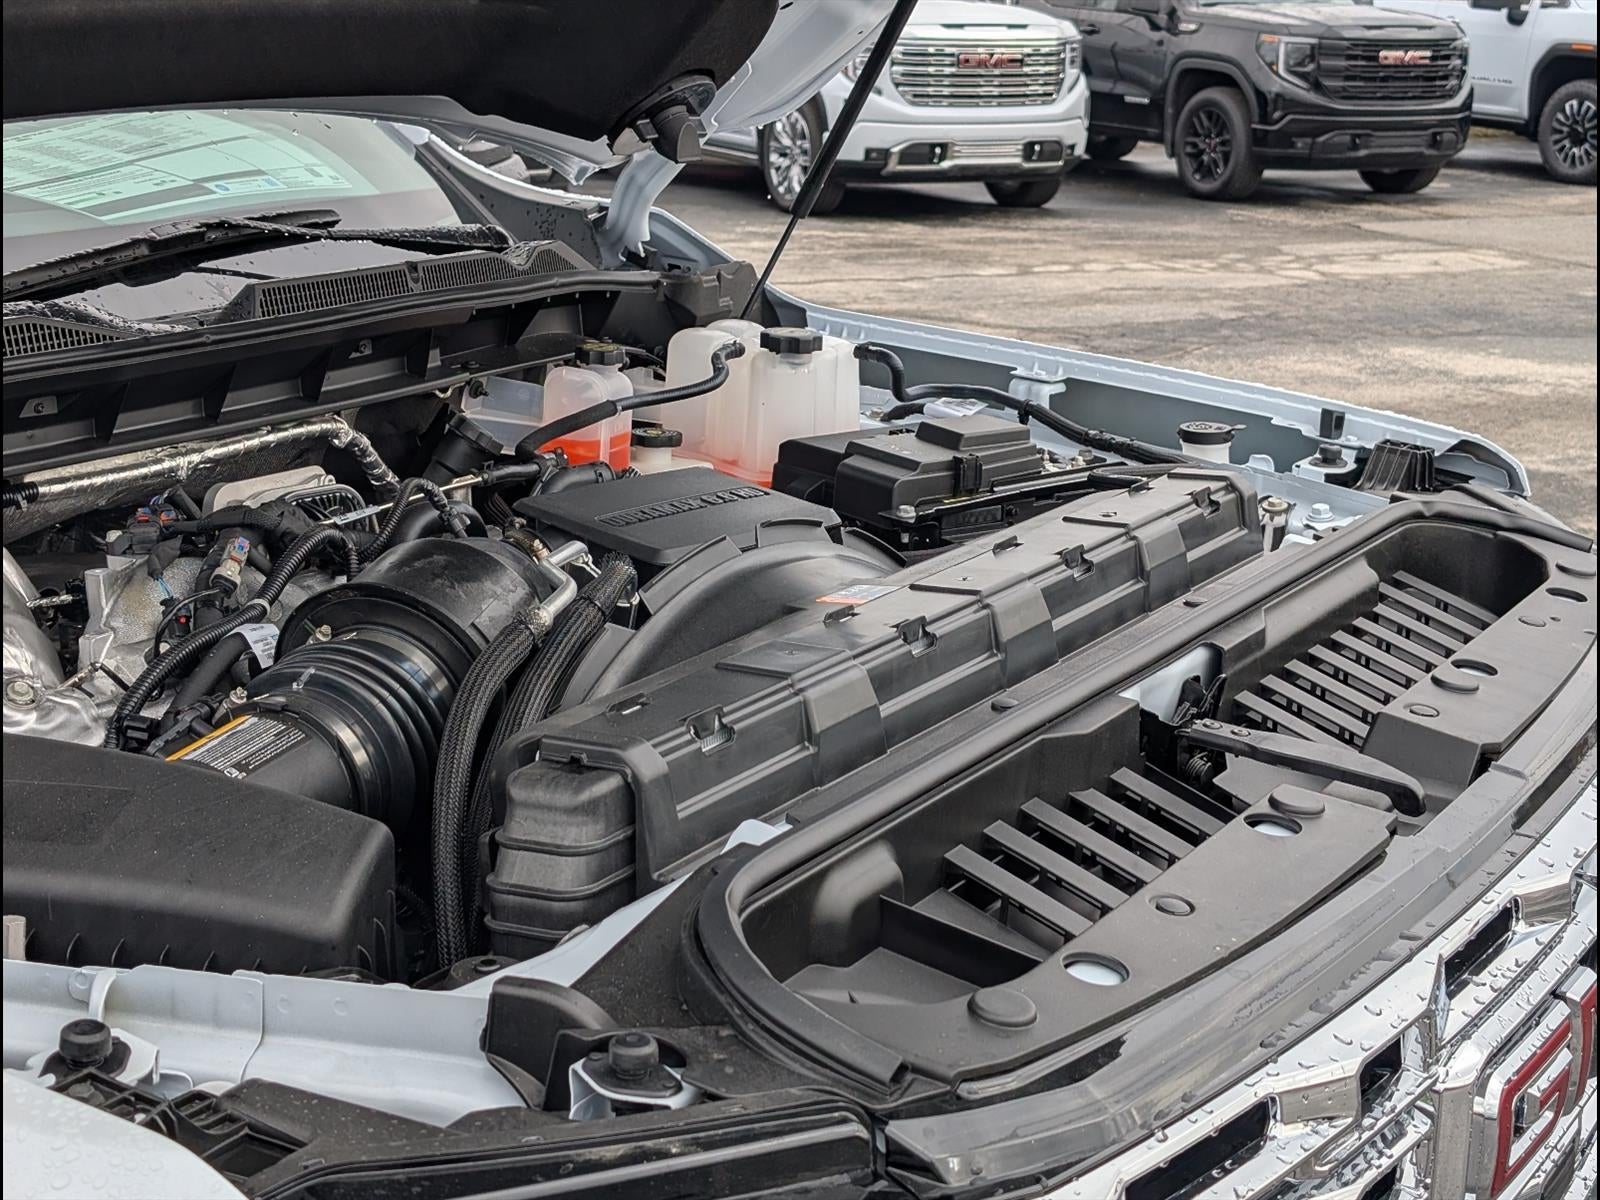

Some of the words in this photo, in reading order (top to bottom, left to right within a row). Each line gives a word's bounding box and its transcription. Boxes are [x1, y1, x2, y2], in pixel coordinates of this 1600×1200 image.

[958, 53, 1023, 69] GMC
[1379, 50, 1432, 65] GMC
[600, 498, 704, 527] DURAMAX
[736, 486, 770, 499] HD
